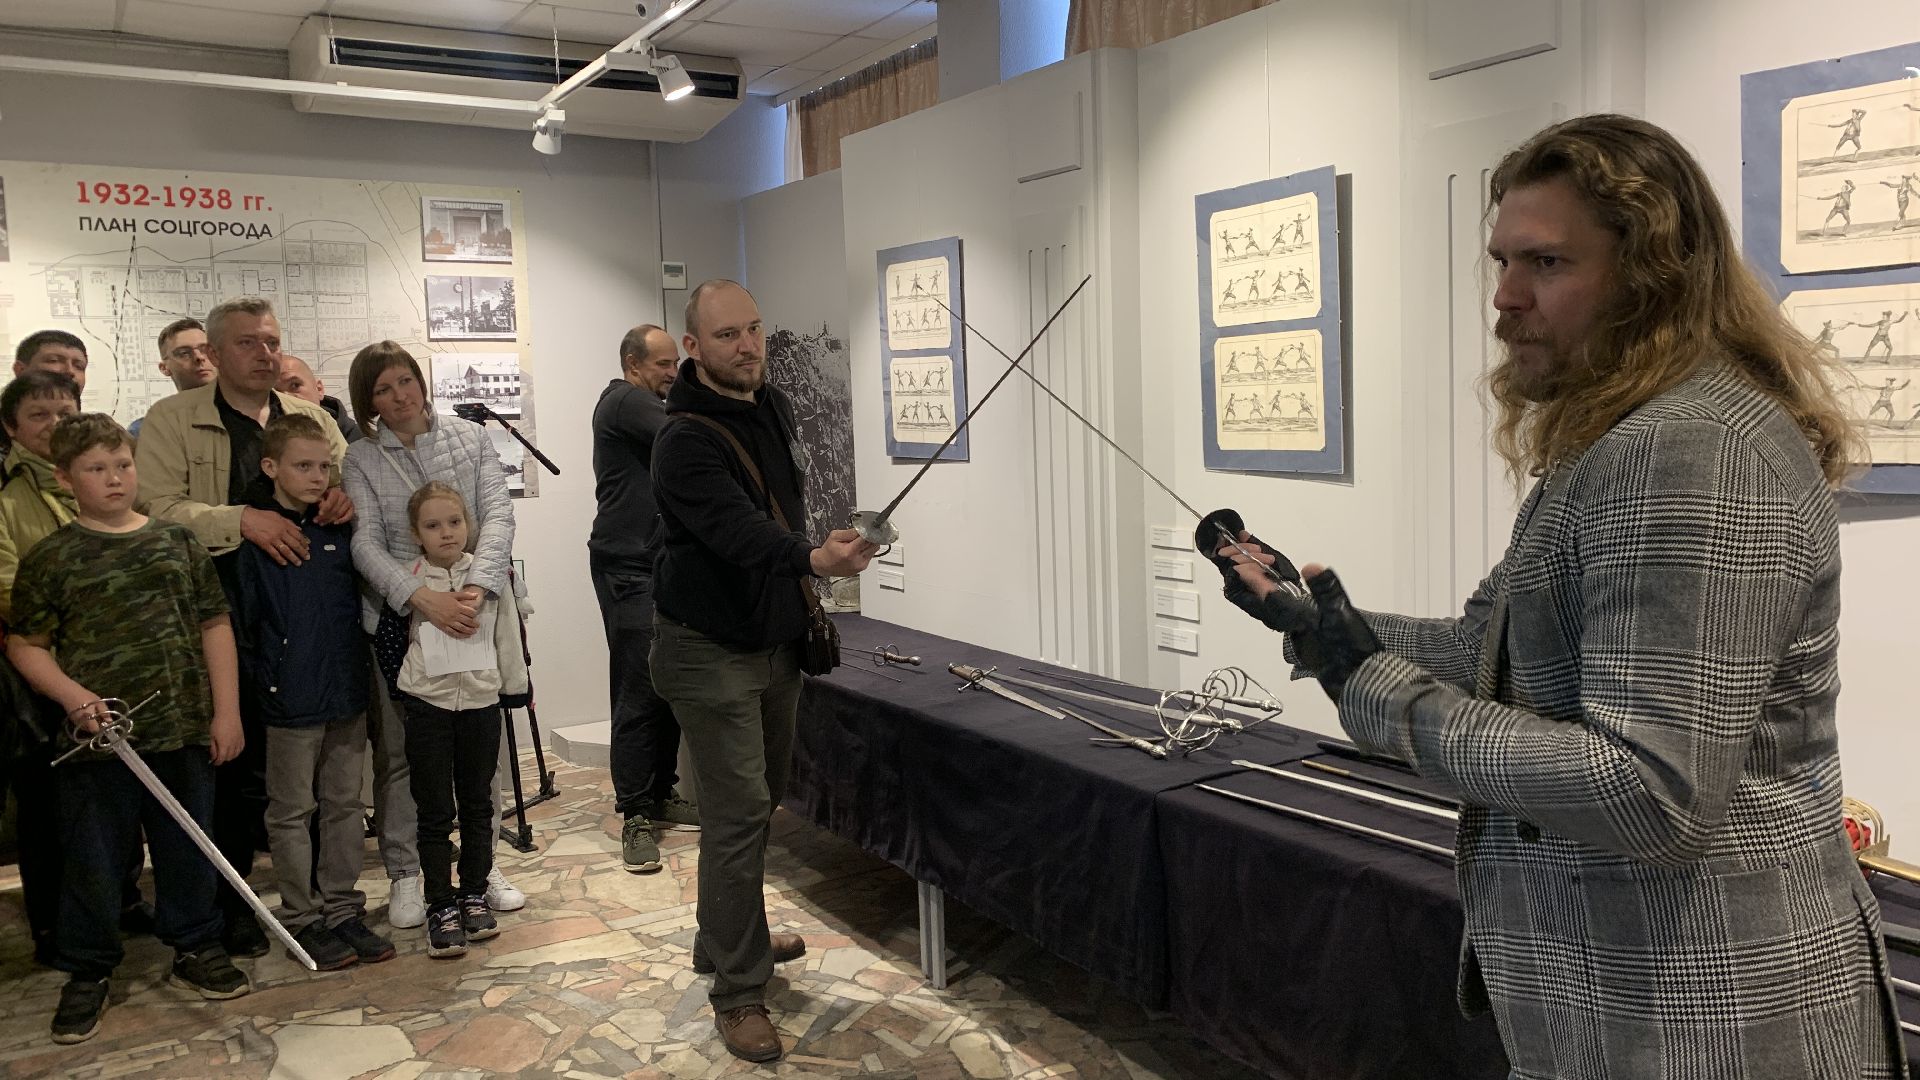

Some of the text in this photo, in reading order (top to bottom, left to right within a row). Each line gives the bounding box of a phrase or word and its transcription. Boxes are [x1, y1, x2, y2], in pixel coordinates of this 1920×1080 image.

[77, 181, 233, 210] 1932-1938
[79, 216, 273, 240] ПЛАН СОЦГОРОДА
